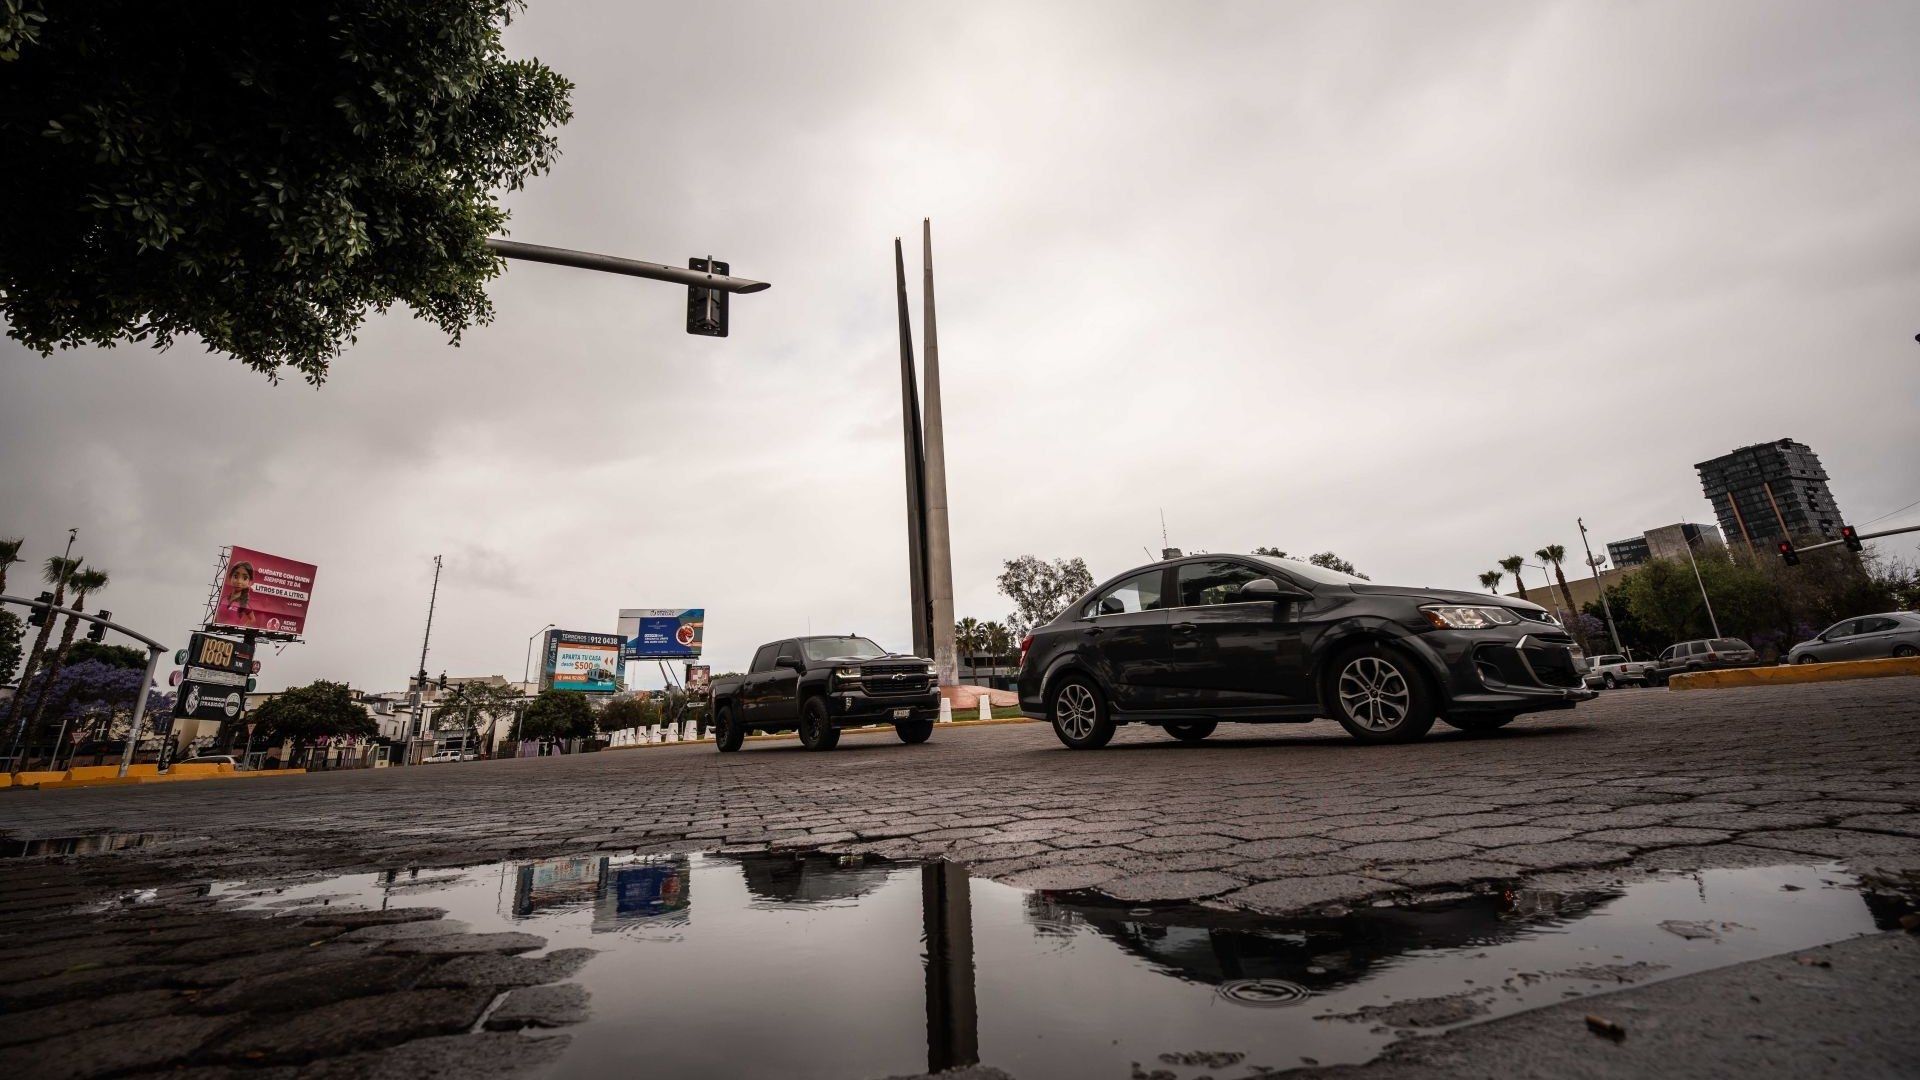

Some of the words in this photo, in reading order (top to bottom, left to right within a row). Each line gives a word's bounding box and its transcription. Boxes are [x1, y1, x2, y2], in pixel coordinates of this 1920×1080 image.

[255, 585, 275, 594] LITROS
[590, 636, 601, 644] 912
[574, 661, 593, 670] $500
